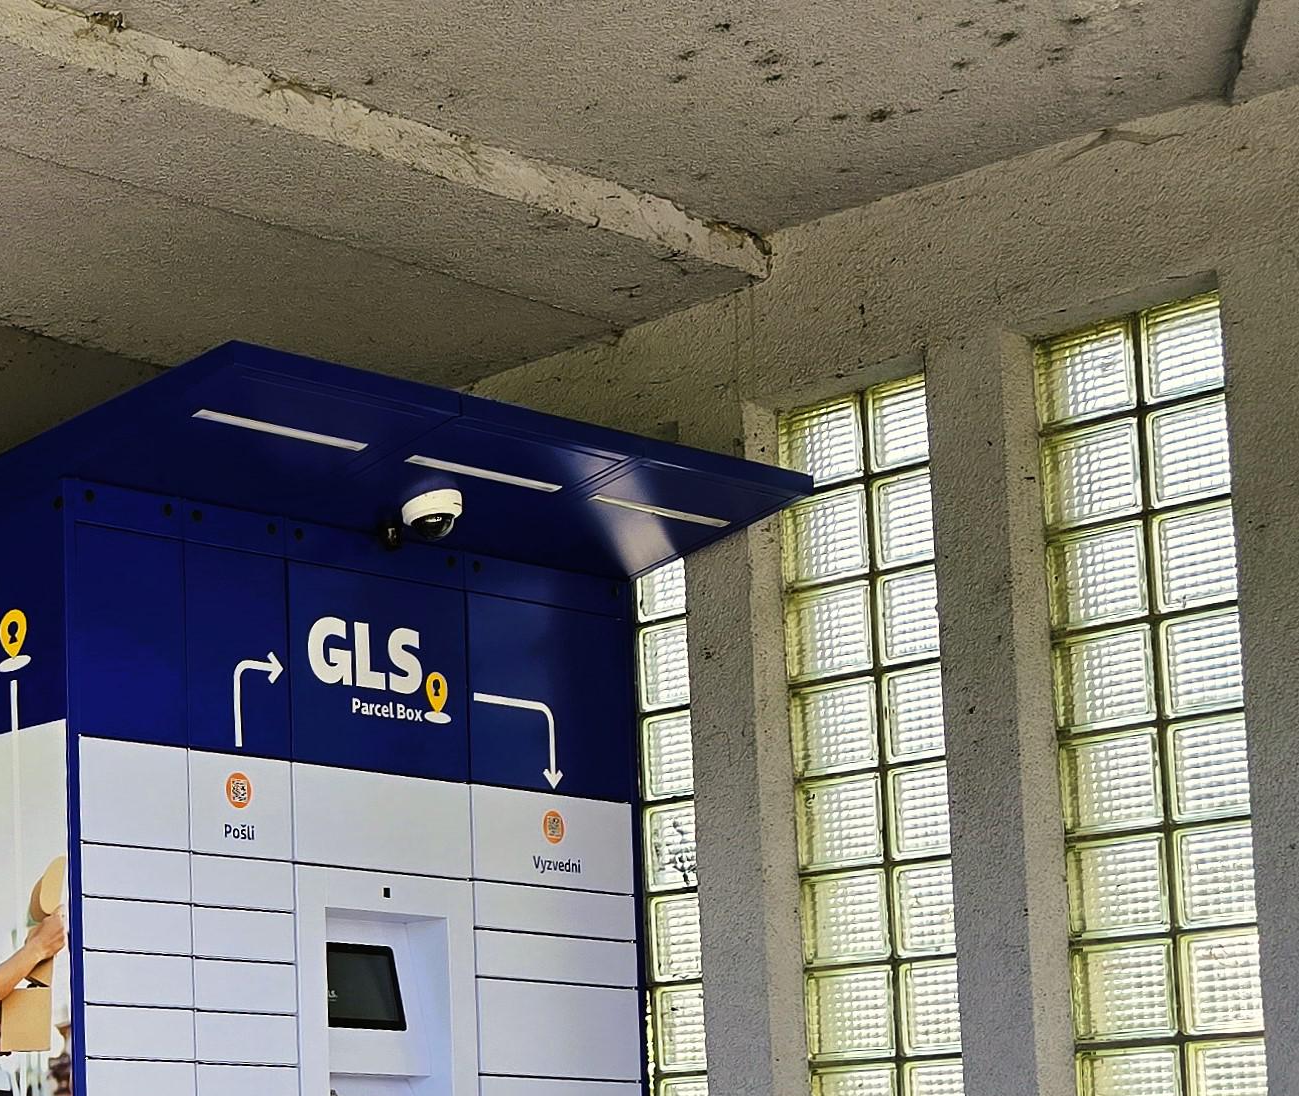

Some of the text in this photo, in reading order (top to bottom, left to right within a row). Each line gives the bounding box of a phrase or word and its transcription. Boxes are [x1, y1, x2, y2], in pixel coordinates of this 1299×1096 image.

[307, 616, 423, 694] GLS
[351, 697, 423, 722] Parcel Box
[224, 823, 255, 841] Pošli
[532, 855, 581, 874] Vyzvedni
